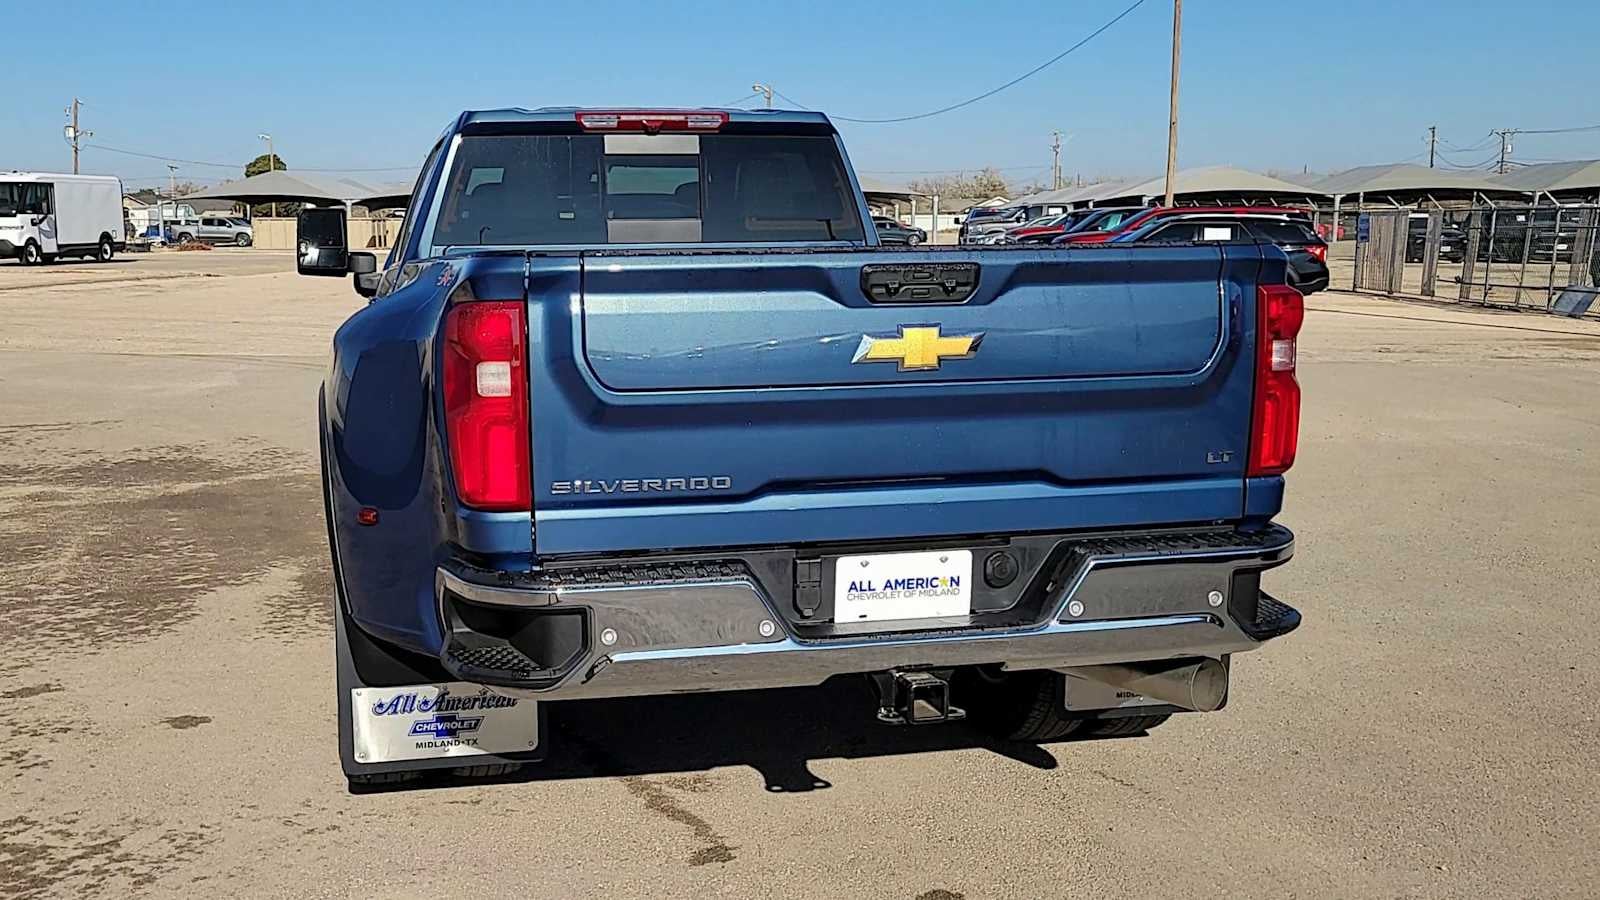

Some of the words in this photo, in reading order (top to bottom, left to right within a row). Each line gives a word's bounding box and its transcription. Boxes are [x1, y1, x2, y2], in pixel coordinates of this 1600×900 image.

[551, 476, 732, 495] SILVERADO
[848, 580, 875, 592] ALL
[847, 591, 902, 601] CHEVROLET
[903, 590, 916, 598] OF
[919, 588, 960, 597] MIDLAND
[372, 694, 416, 716] All
[417, 690, 520, 713] American
[415, 719, 477, 732] CHEVROLET
